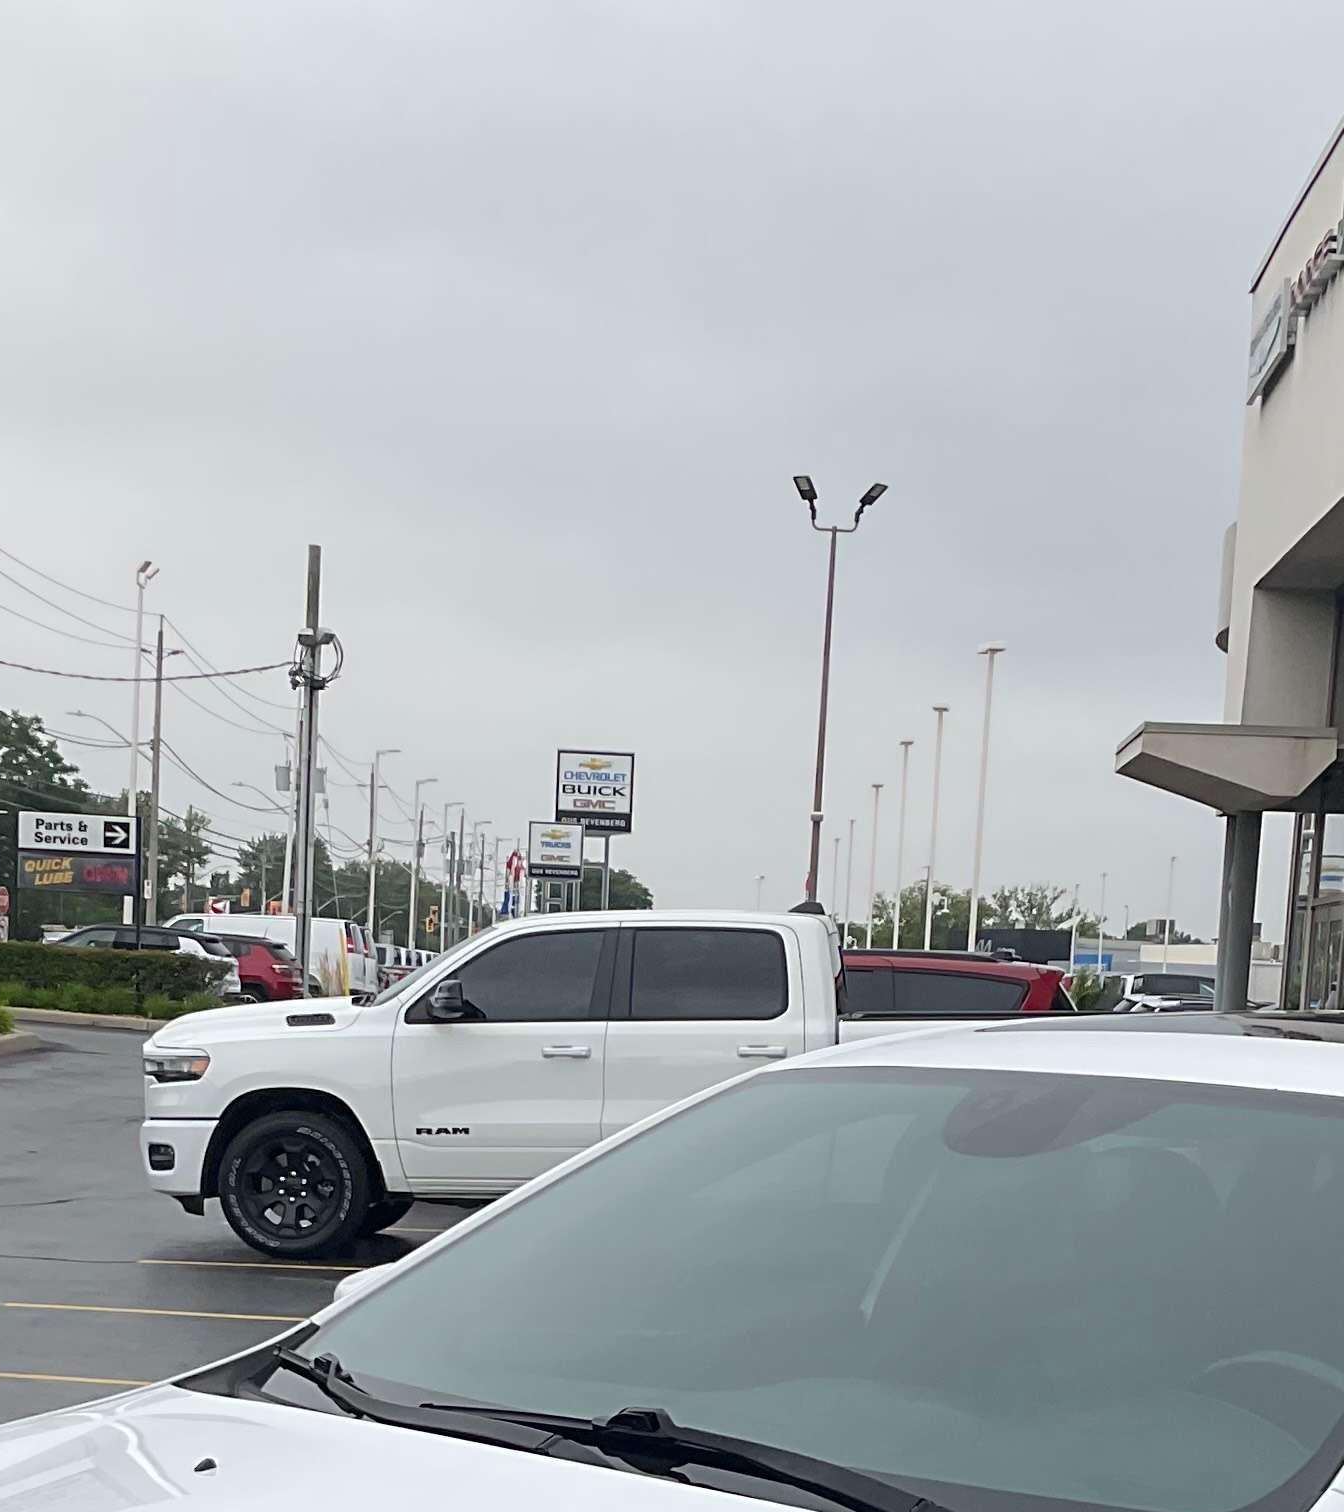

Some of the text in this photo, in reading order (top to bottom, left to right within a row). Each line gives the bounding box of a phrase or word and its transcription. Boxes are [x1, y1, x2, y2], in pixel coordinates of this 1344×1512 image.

[564, 770, 627, 782] CHEVROLET
[562, 784, 626, 797] BUICK
[573, 799, 616, 810] GMC
[35, 818, 88, 832] Parts &
[34, 831, 88, 846] Service
[24, 857, 73, 873] QUICK
[34, 871, 74, 886] LUBE
[415, 1127, 471, 1136] RAM
